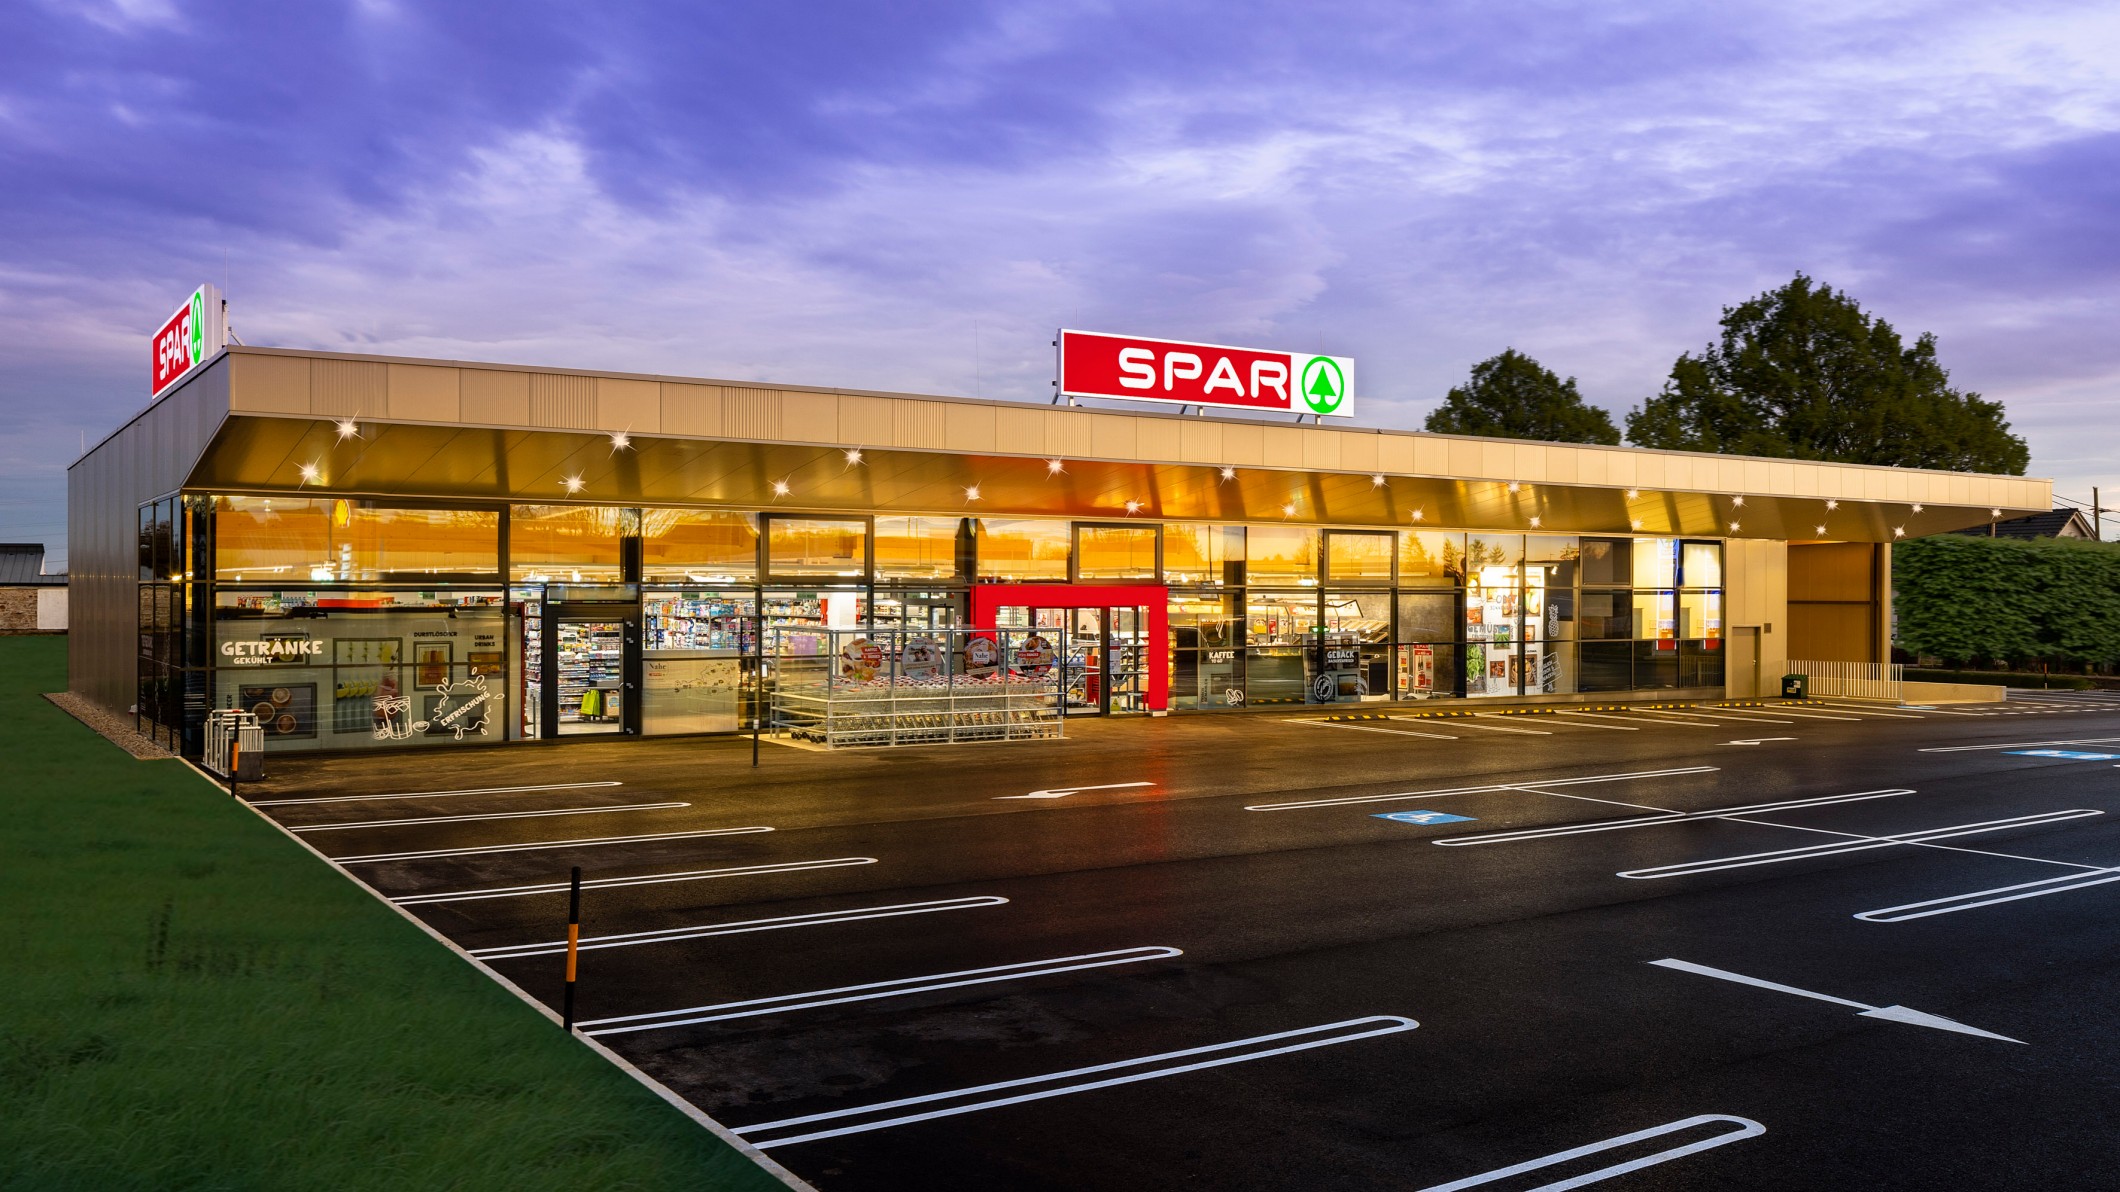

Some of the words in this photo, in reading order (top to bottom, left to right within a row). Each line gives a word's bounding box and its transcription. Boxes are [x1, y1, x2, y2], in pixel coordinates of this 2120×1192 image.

[159, 314, 190, 381] SPAR
[1118, 347, 1288, 401] SPAR
[221, 638, 324, 656] GETRÄNKE
[233, 655, 274, 665] GEKÜHLT
[1208, 651, 1235, 659] KAFFEE
[440, 690, 491, 727] ERFRISCHUNG
